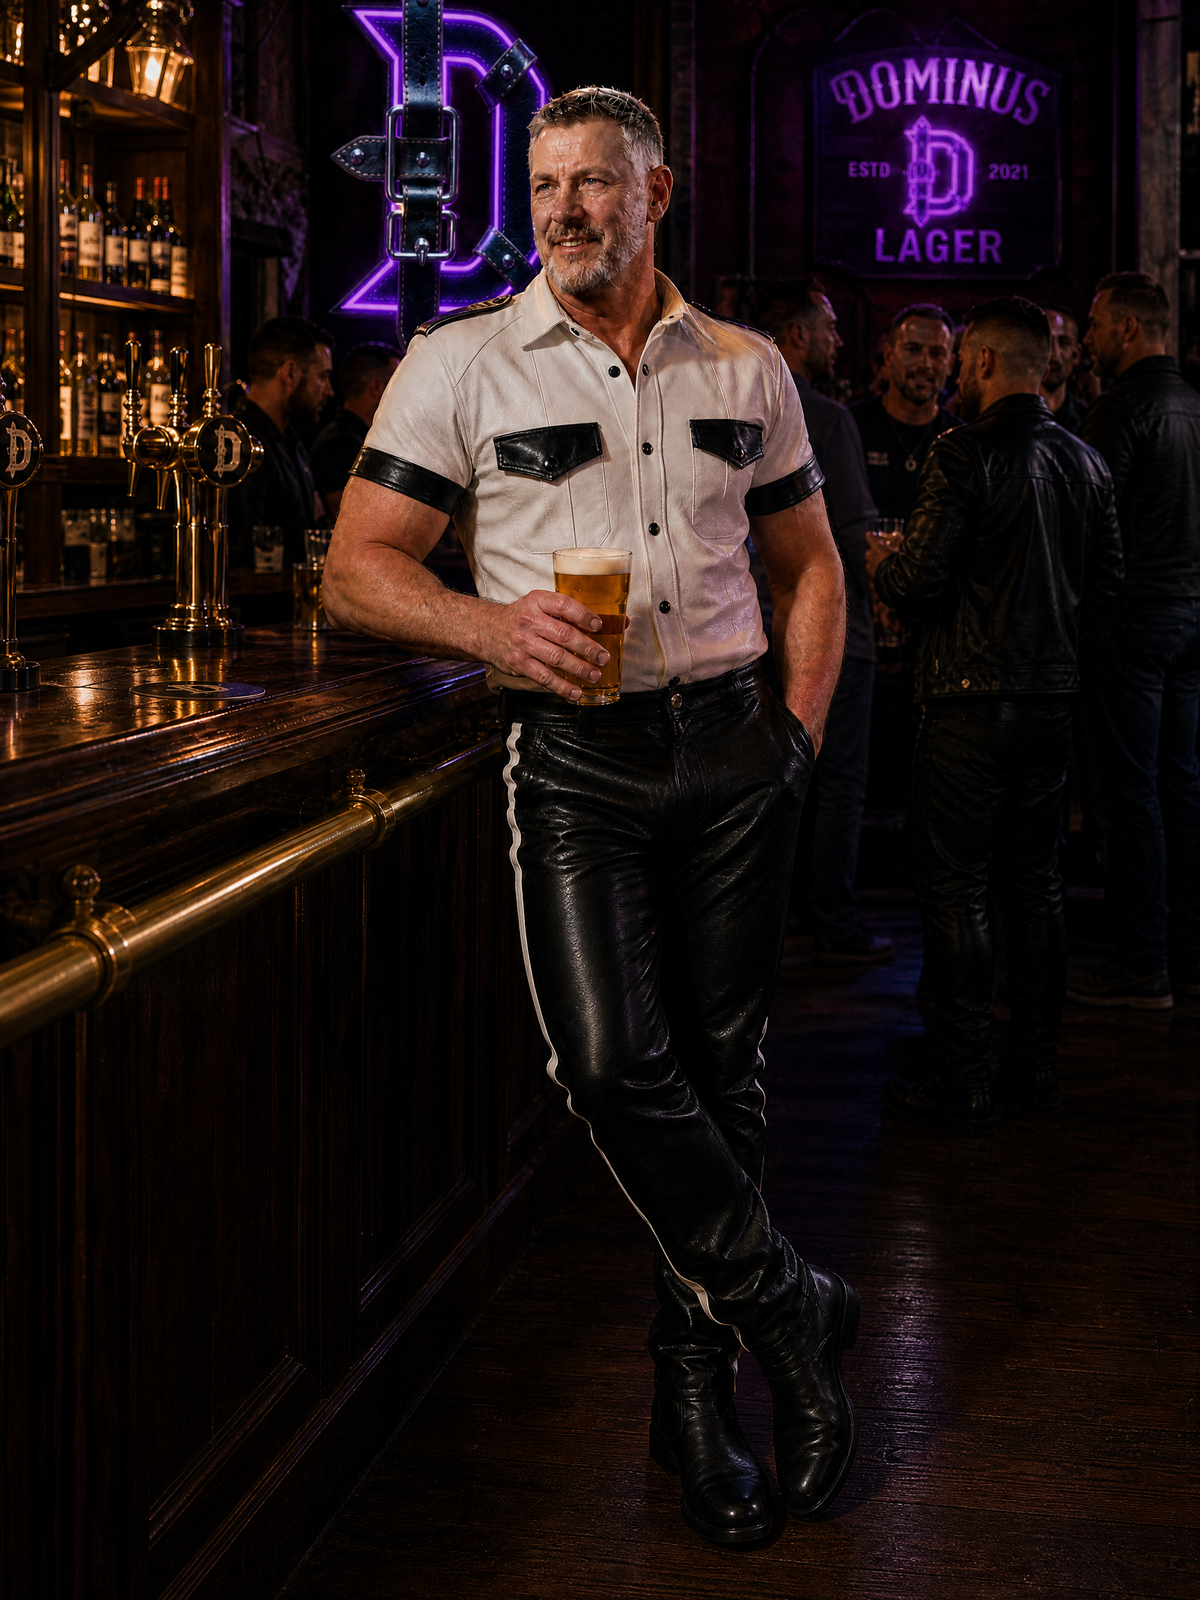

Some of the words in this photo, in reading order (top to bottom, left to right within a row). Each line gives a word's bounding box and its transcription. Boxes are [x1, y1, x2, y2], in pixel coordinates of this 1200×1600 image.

[829, 57, 1050, 126] DOMINUS
[329, 4, 549, 314] D
[848, 161, 891, 178] ESTD
[988, 163, 1029, 180] 2021
[903, 116, 975, 228] D
[875, 228, 1003, 263] LAGER
[5, 421, 32, 478] D
[213, 424, 241, 478] D
